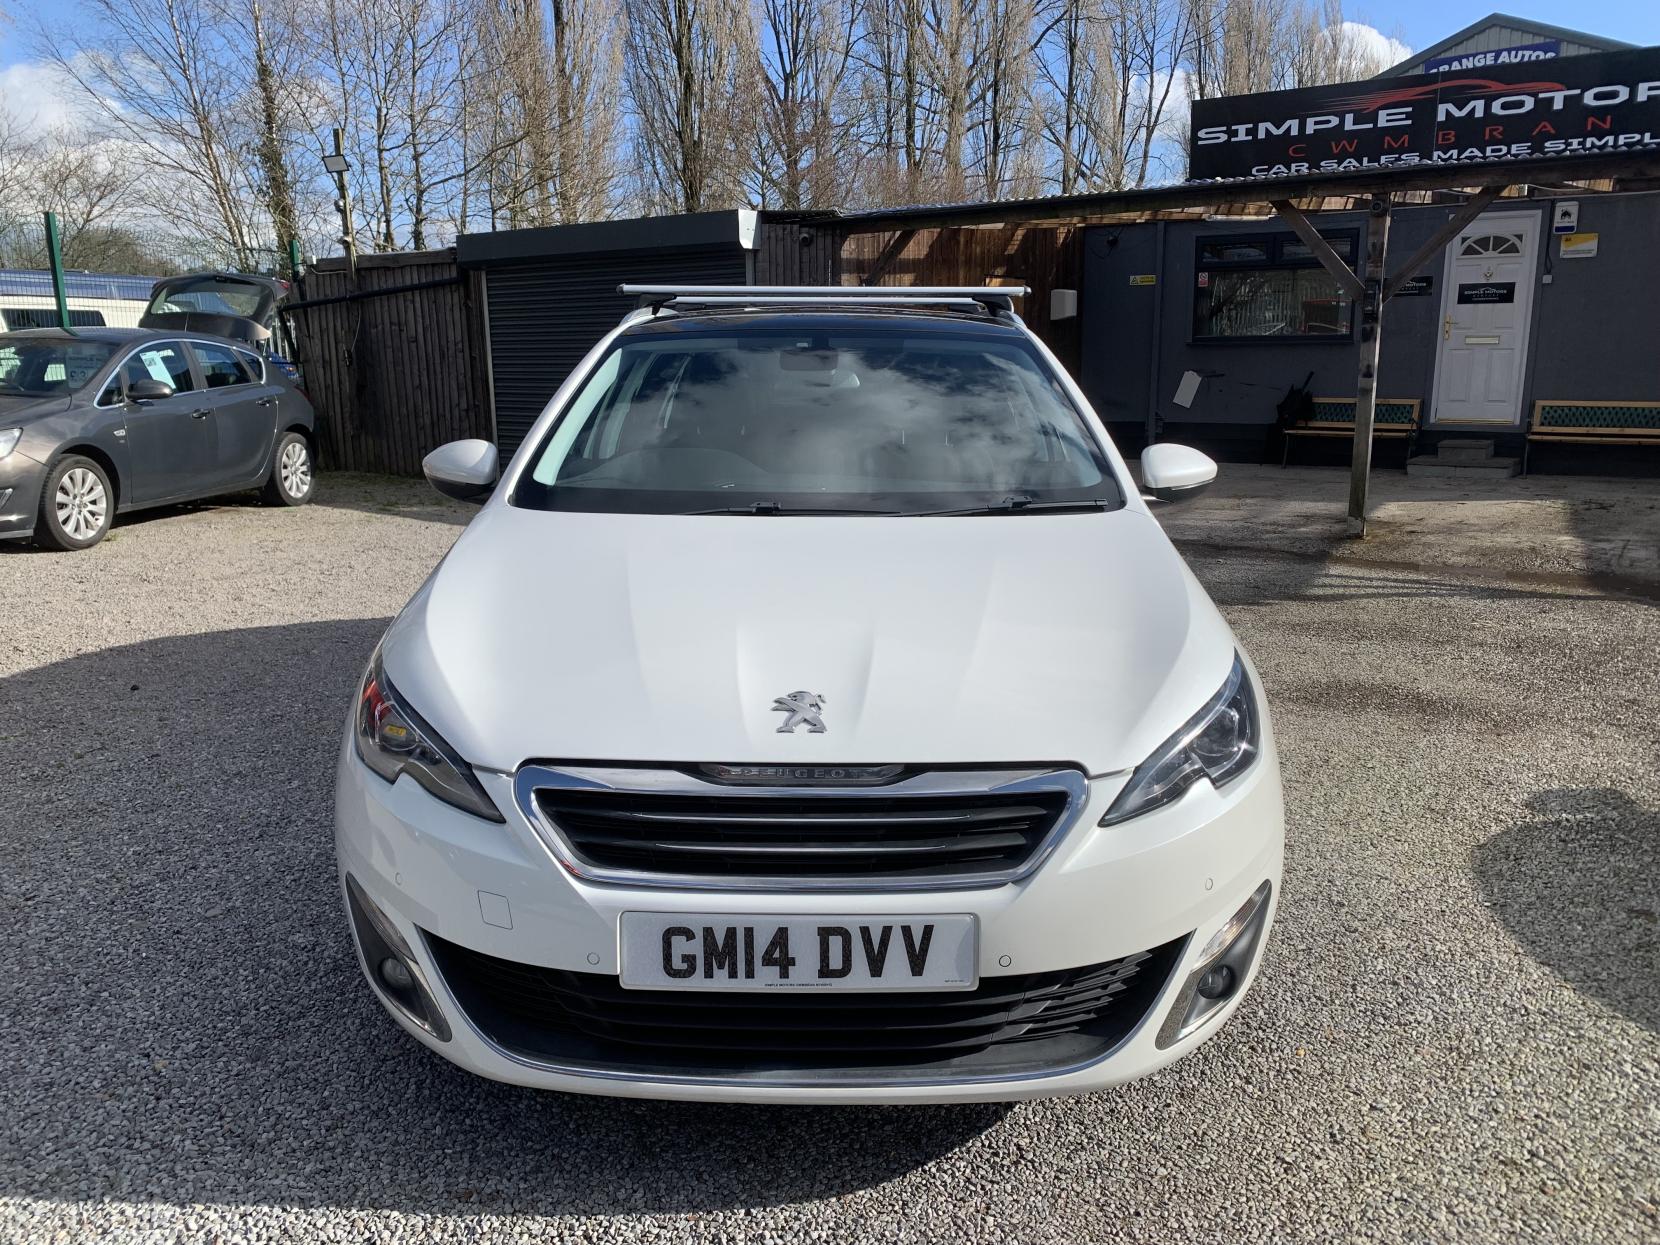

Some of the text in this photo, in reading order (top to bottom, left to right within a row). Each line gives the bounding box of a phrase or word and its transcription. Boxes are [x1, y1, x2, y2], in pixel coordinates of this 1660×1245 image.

[1197, 107, 1413, 145] SIMPLE
[1251, 162, 1309, 177] CAR
[1432, 143, 1532, 161] MADE
[661, 924, 935, 979] GM14 DVV
